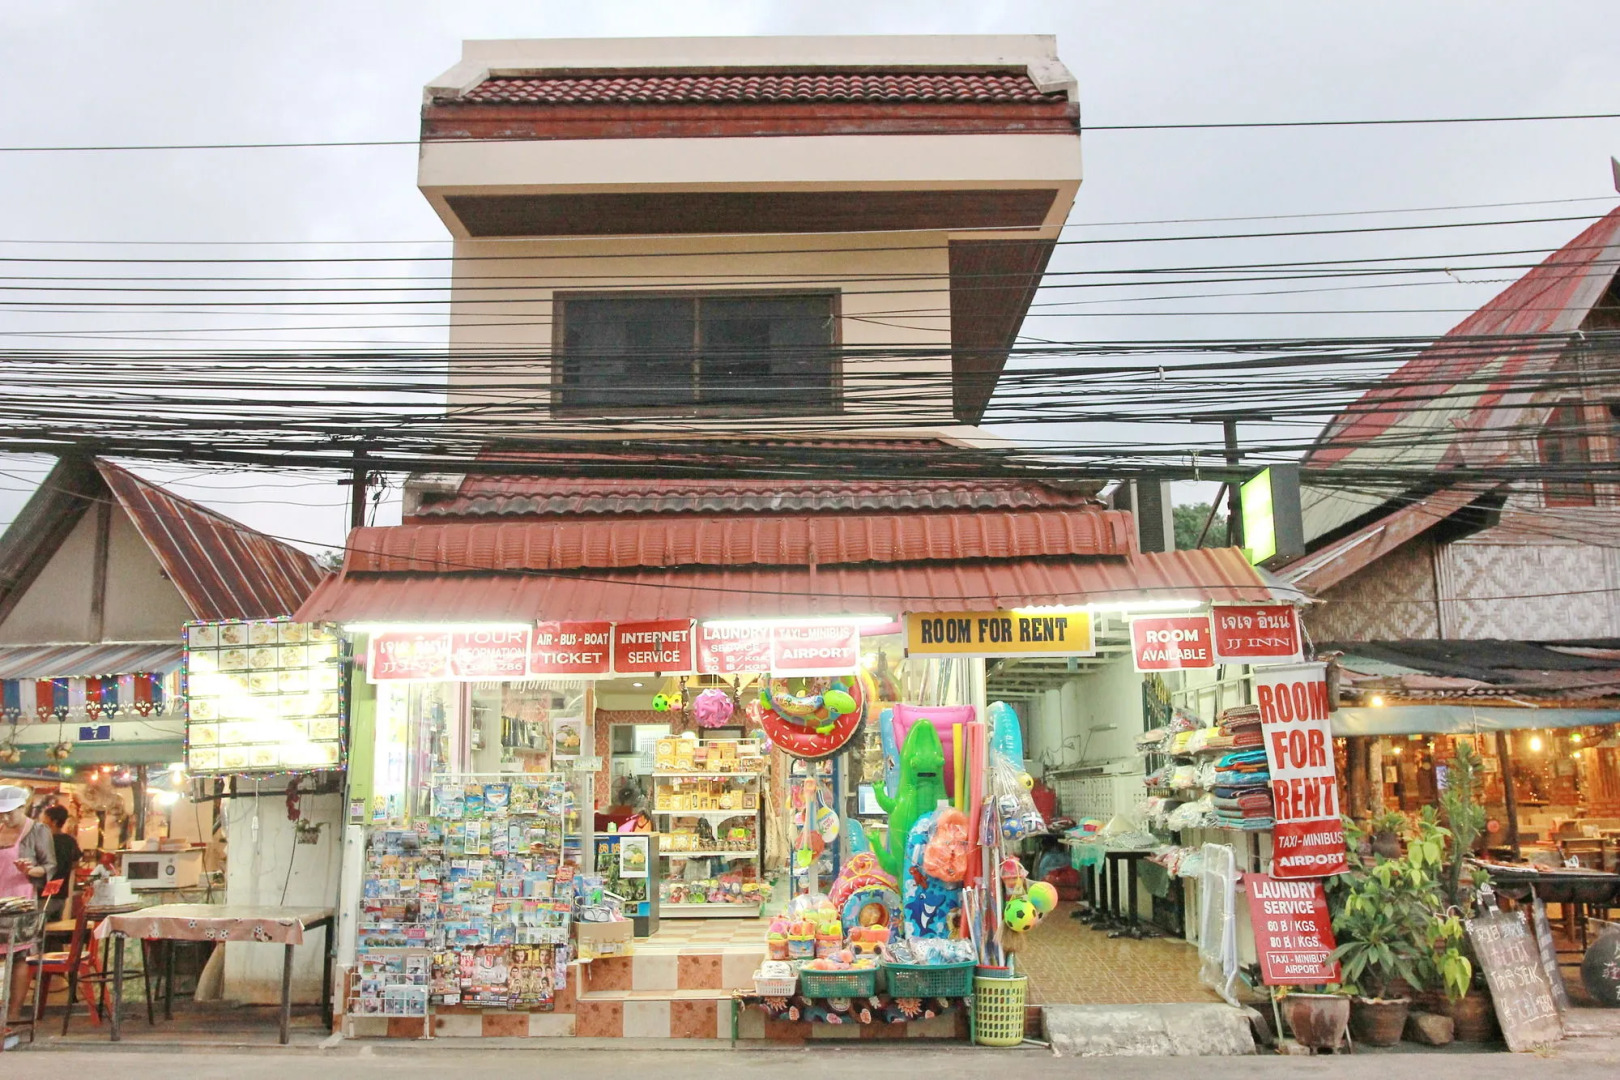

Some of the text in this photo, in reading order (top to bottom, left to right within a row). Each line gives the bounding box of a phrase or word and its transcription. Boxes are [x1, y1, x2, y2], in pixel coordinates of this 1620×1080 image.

[463, 629, 522, 643] TOUR
[621, 630, 688, 643] INTERNET
[703, 627, 769, 640] LAUNDRY
[921, 617, 1067, 644] ROOM FOR RENT
[1145, 628, 1199, 644] ROOM
[537, 634, 552, 645] AIR
[560, 633, 577, 645] BUS
[584, 632, 609, 645] BOAT
[1226, 638, 1290, 650] JJ INN
[457, 647, 525, 657] INFORMATION
[542, 652, 603, 664] TICKET
[628, 650, 681, 664] SERVICE
[782, 647, 850, 659] AIRPORT
[1142, 647, 1206, 662] AVAILABLE
[1257, 681, 1329, 724] ROOM
[92, 730, 98, 738] 7
[1271, 729, 1326, 769] FOR
[1273, 776, 1335, 820] RENT
[1279, 852, 1344, 867] AIRPORT
[1252, 881, 1316, 899] LAUNDRY
[1264, 901, 1315, 914] SERVICE
[1267, 920, 1278, 931] 60
[1294, 920, 1318, 931] KGS.
[1297, 936, 1321, 947] KGS.
[1270, 955, 1289, 964] TAXI
[1294, 954, 1327, 963] MINIBUS
[1285, 965, 1320, 974] AIRPORT
